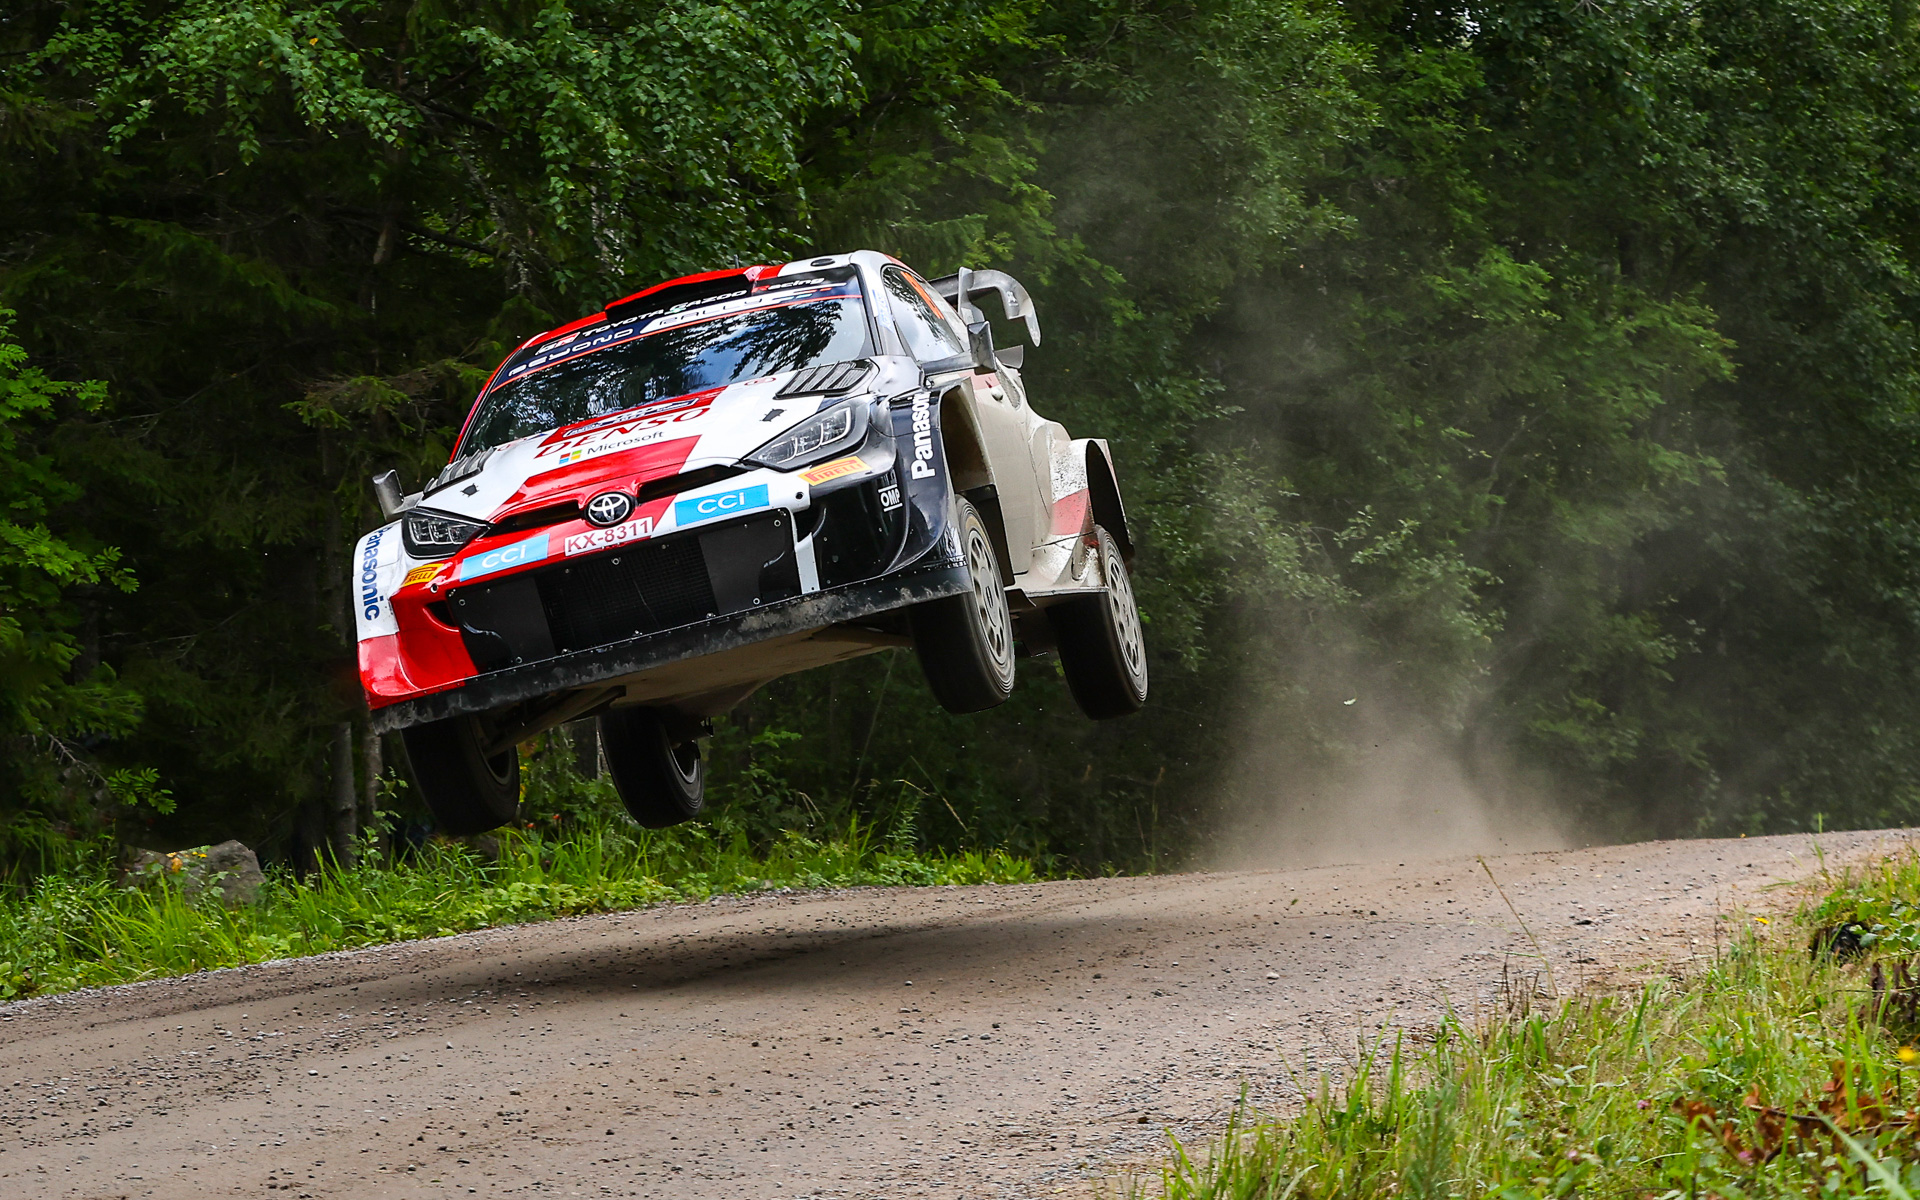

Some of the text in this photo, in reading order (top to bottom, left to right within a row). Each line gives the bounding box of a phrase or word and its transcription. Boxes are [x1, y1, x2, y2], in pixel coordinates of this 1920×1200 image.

[582, 309, 664, 337] TOYOTA
[665, 289, 748, 315] GAZOO
[508, 328, 634, 377] BEYOND
[534, 407, 711, 460] DENSO
[587, 431, 664, 455] Microsoft
[805, 459, 863, 482] PIRELLI
[880, 488, 900, 507] OMP
[567, 520, 650, 553] KX-8311
[362, 526, 393, 621] Panasonic
